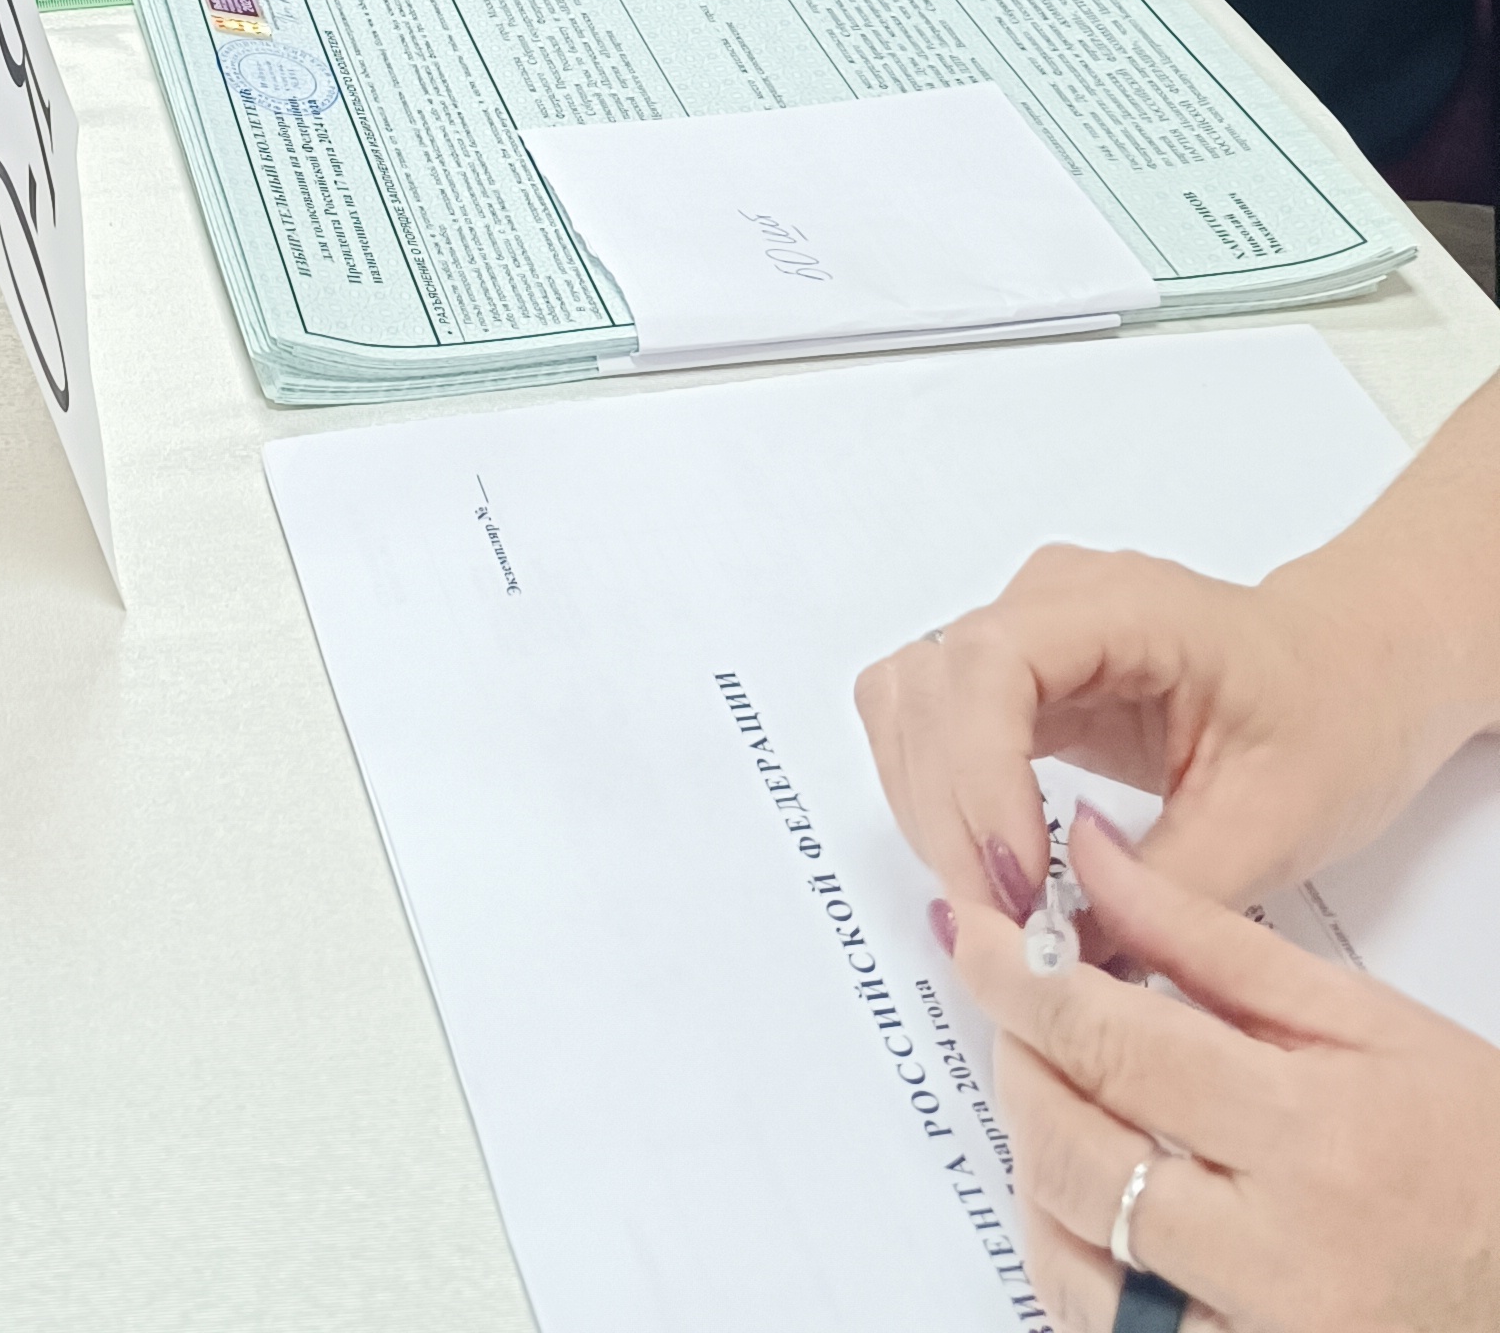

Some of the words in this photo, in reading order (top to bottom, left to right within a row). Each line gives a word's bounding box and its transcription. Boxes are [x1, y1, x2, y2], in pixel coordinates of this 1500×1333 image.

[324, 30, 349, 74] БЮЛЛЕТЕНЯ
[239, 88, 272, 161] БЮЛЛЕТЕНЬ
[273, 110, 295, 152] выборах
[307, 99, 322, 119] года
[313, 122, 331, 143] 2024
[343, 76, 377, 147] ИЗБИРАТЕЛЬНОГО
[289, 155, 300, 168] на
[306, 156, 337, 215] Российской
[325, 147, 342, 176] марта
[333, 180, 349, 190] 17
[371, 149, 400, 203] ЗАПОЛНЕНИЯ
[263, 165, 311, 276] ИЗБИРАТЕЛЬНЫЙ
[294, 171, 323, 237] голосования
[343, 194, 354, 207] на
[393, 207, 417, 245] ПОРЯДКЕ
[1183, 191, 1244, 259] ХАРИТОНОВ
[1229, 192, 1282, 253] Михайлович
[318, 241, 333, 261] для
[331, 219, 361, 283] Президента
[349, 210, 382, 283] назначенных
[1225, 213, 1266, 256] Николай
[414, 257, 448, 323] РАЗЪЯСНЕНИЕ
[485, 523, 521, 595] Экземпляр
[714, 670, 821, 860] ФЕДЕРАЦИИ
[807, 871, 952, 1140] РОССИЙСКОЙ
[914, 978, 943, 1033] года
[936, 1037, 980, 1093] 2024
[971, 1100, 1014, 1178] марта
